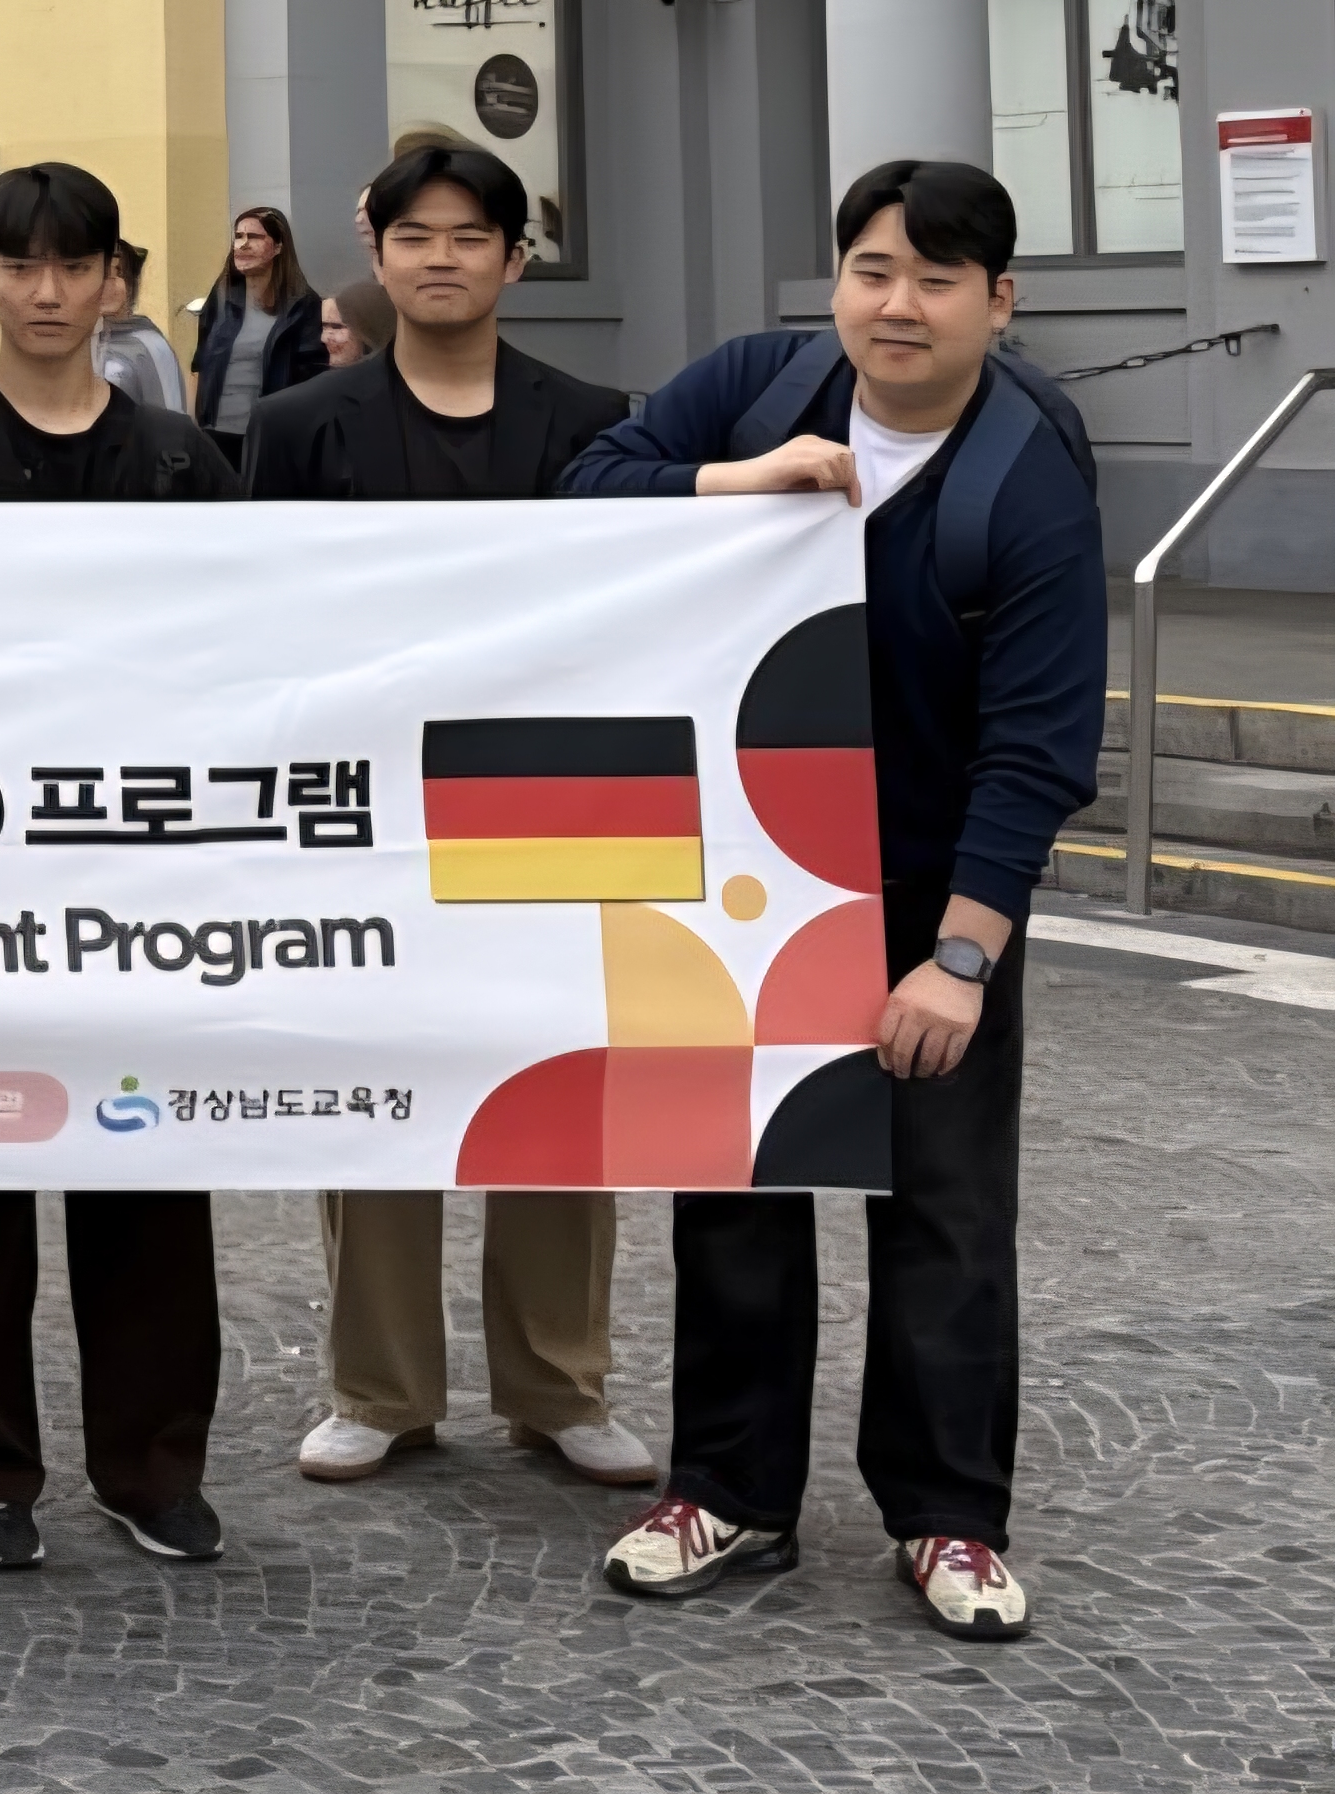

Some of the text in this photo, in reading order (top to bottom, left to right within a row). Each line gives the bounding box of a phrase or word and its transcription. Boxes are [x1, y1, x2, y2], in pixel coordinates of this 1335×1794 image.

[24, 759, 374, 849] 프로그램
[64, 907, 396, 988] Program
[167, 1086, 413, 1123] 경상남도교육청
